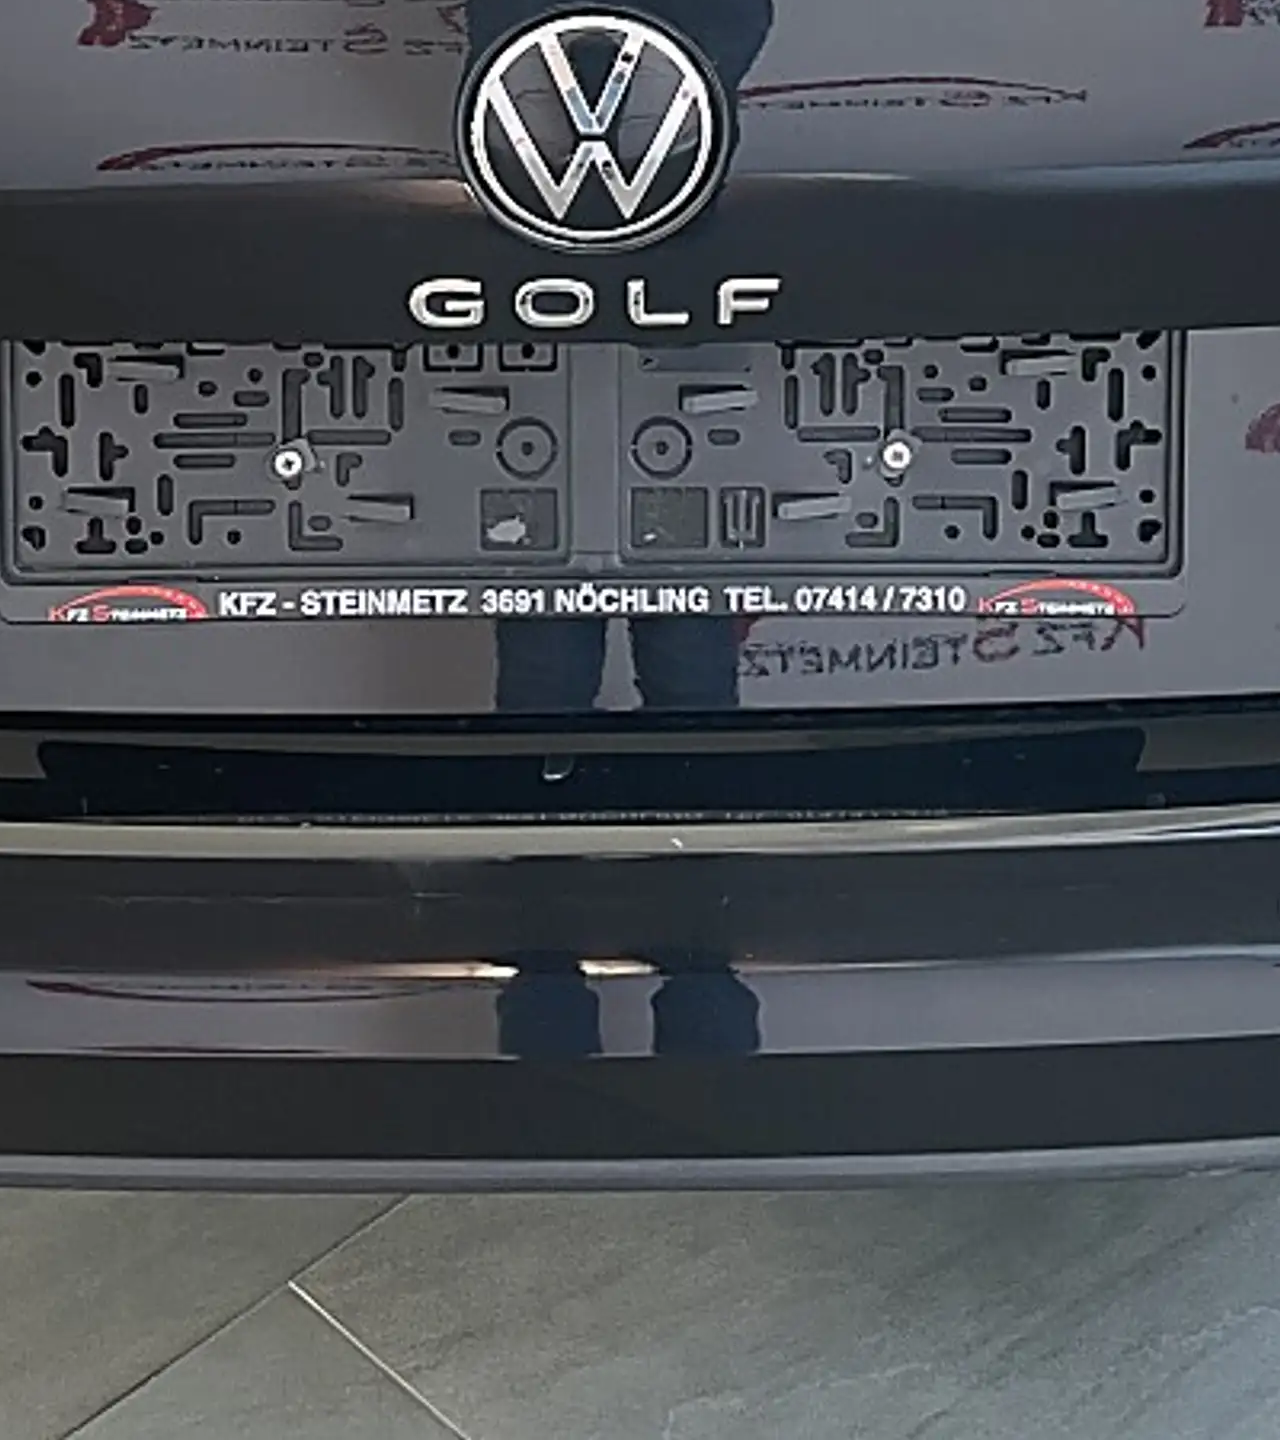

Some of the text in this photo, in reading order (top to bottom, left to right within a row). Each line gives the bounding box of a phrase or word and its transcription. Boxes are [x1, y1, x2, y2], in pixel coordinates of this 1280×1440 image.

[408, 277, 783, 327] GOLF
[220, 592, 277, 616] KFZ
[300, 589, 469, 615] STEINMETZ
[481, 589, 544, 613] 3691
[555, 582, 709, 613] NÖCHLING
[723, 586, 788, 612] TEL.
